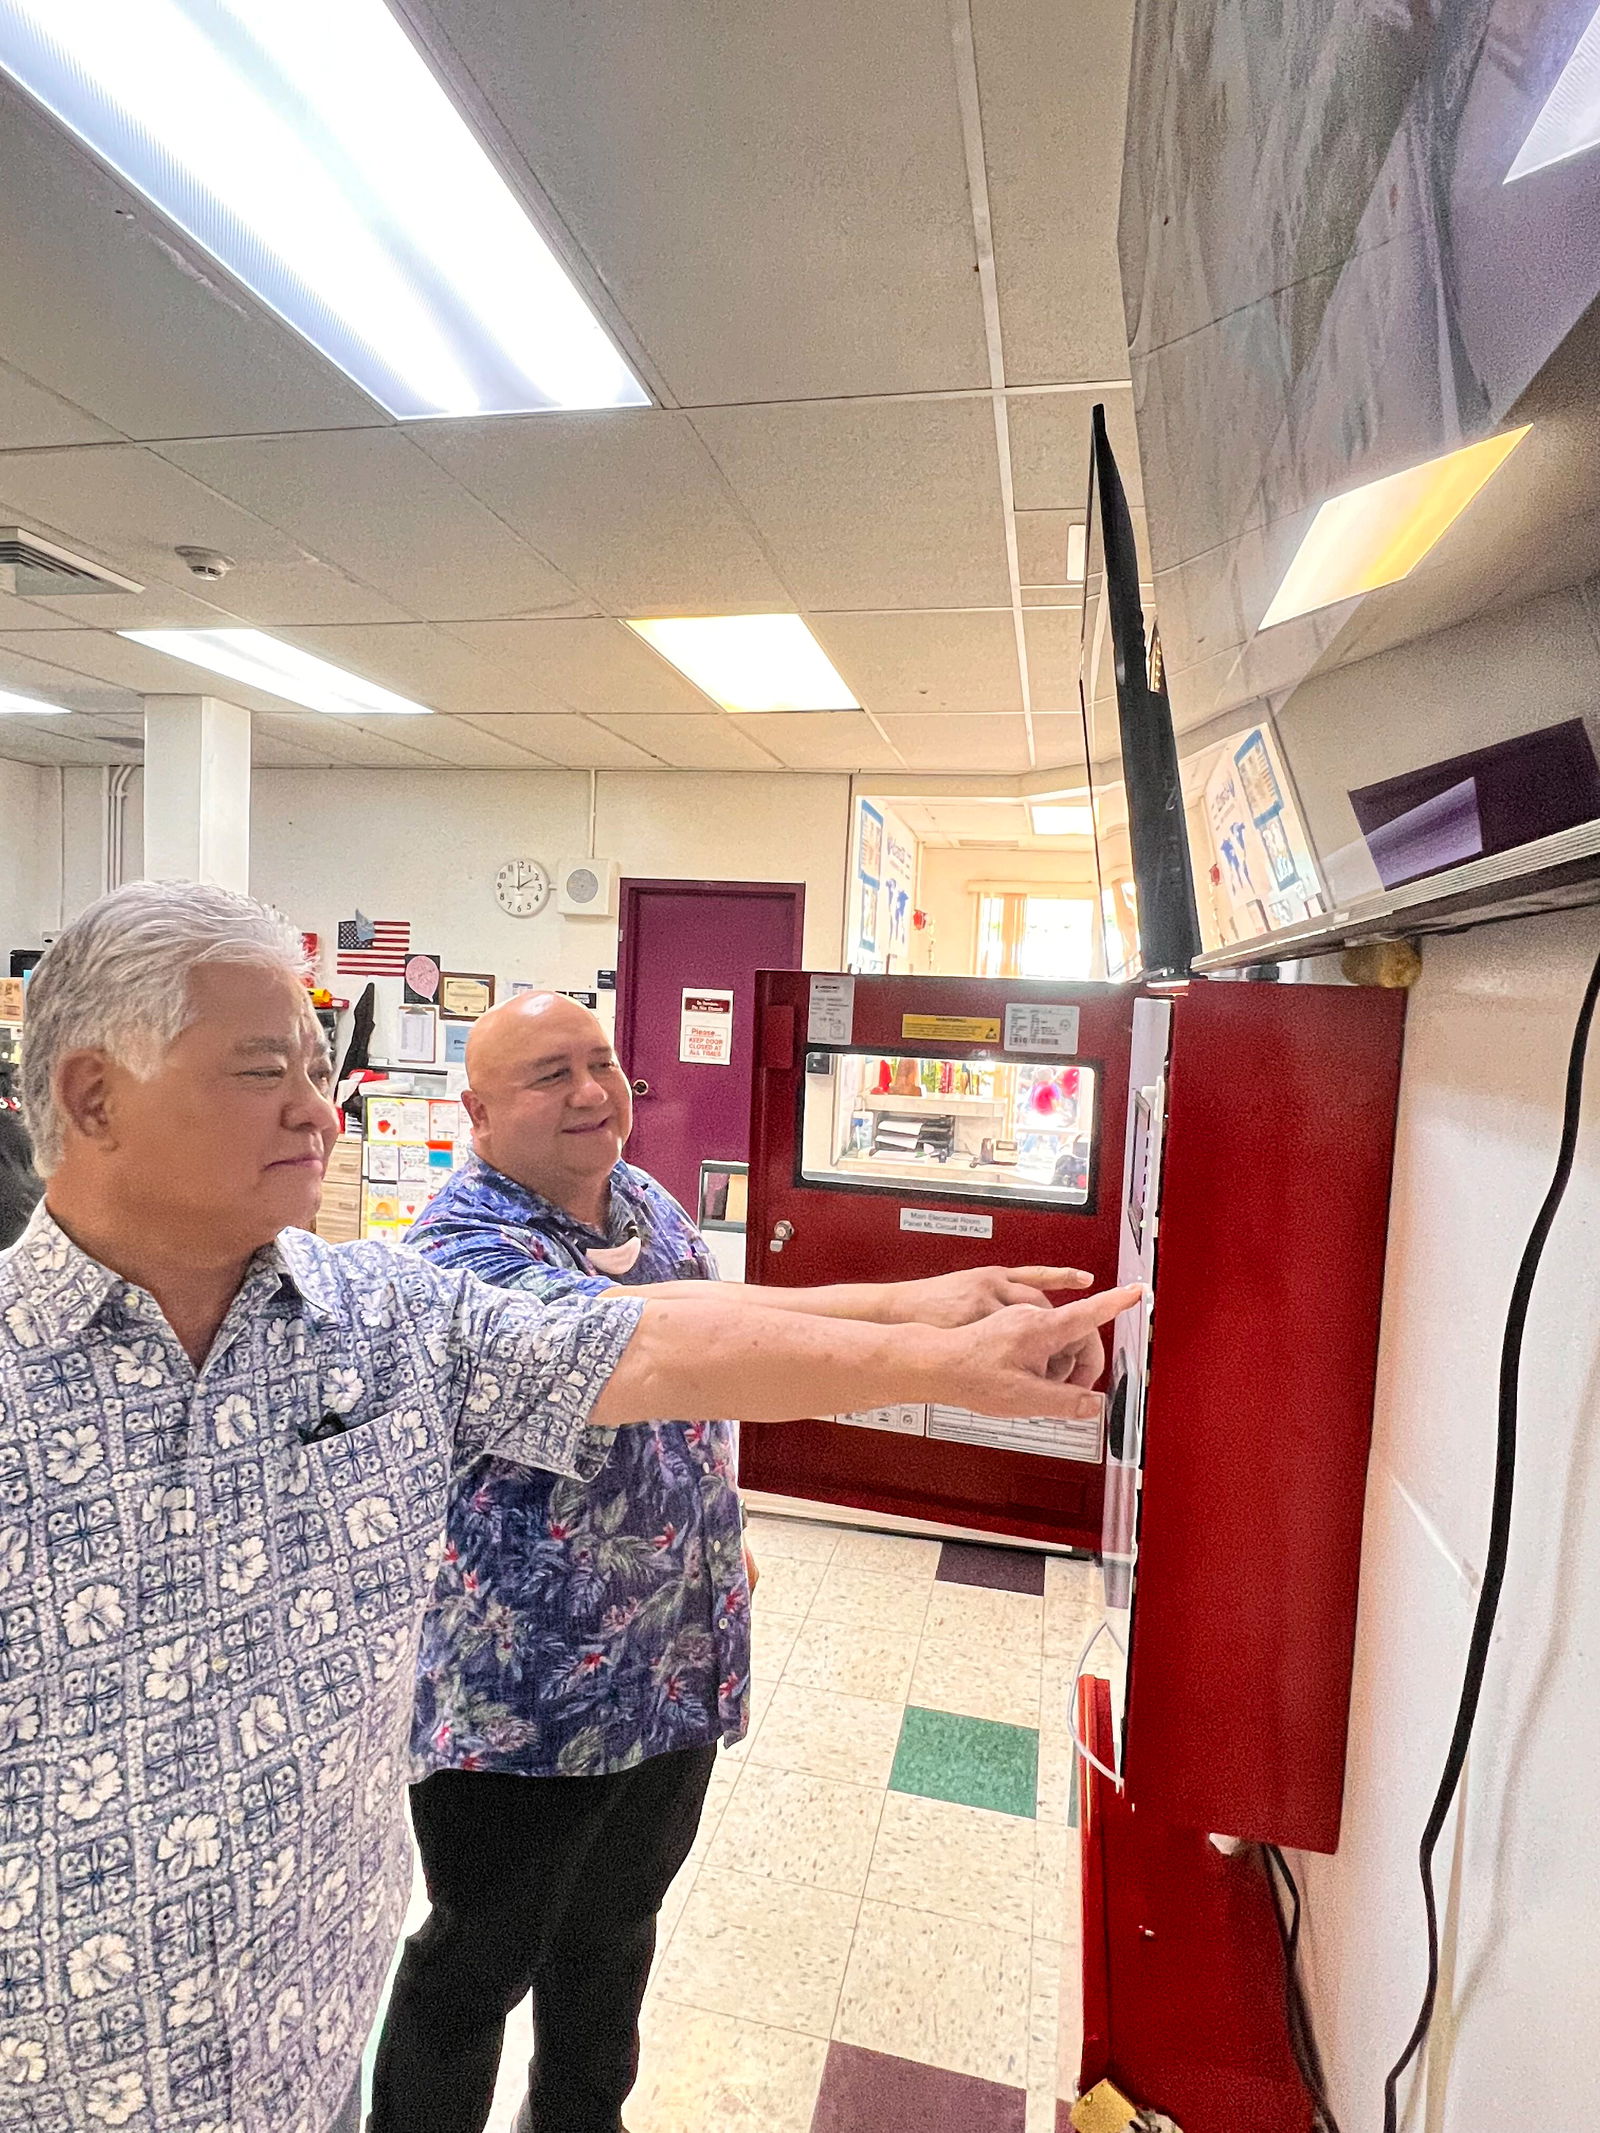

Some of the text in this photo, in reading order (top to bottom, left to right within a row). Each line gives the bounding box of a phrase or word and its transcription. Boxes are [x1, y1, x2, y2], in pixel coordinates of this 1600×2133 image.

[499, 872, 507, 880] 10
[534, 873, 540, 881] 2
[497, 882, 503, 890] 9
[537, 883, 543, 892] 3
[499, 893, 505, 901] 8
[507, 901, 513, 910] 7
[516, 905, 522, 913] 6
[526, 902, 532, 911] 5
